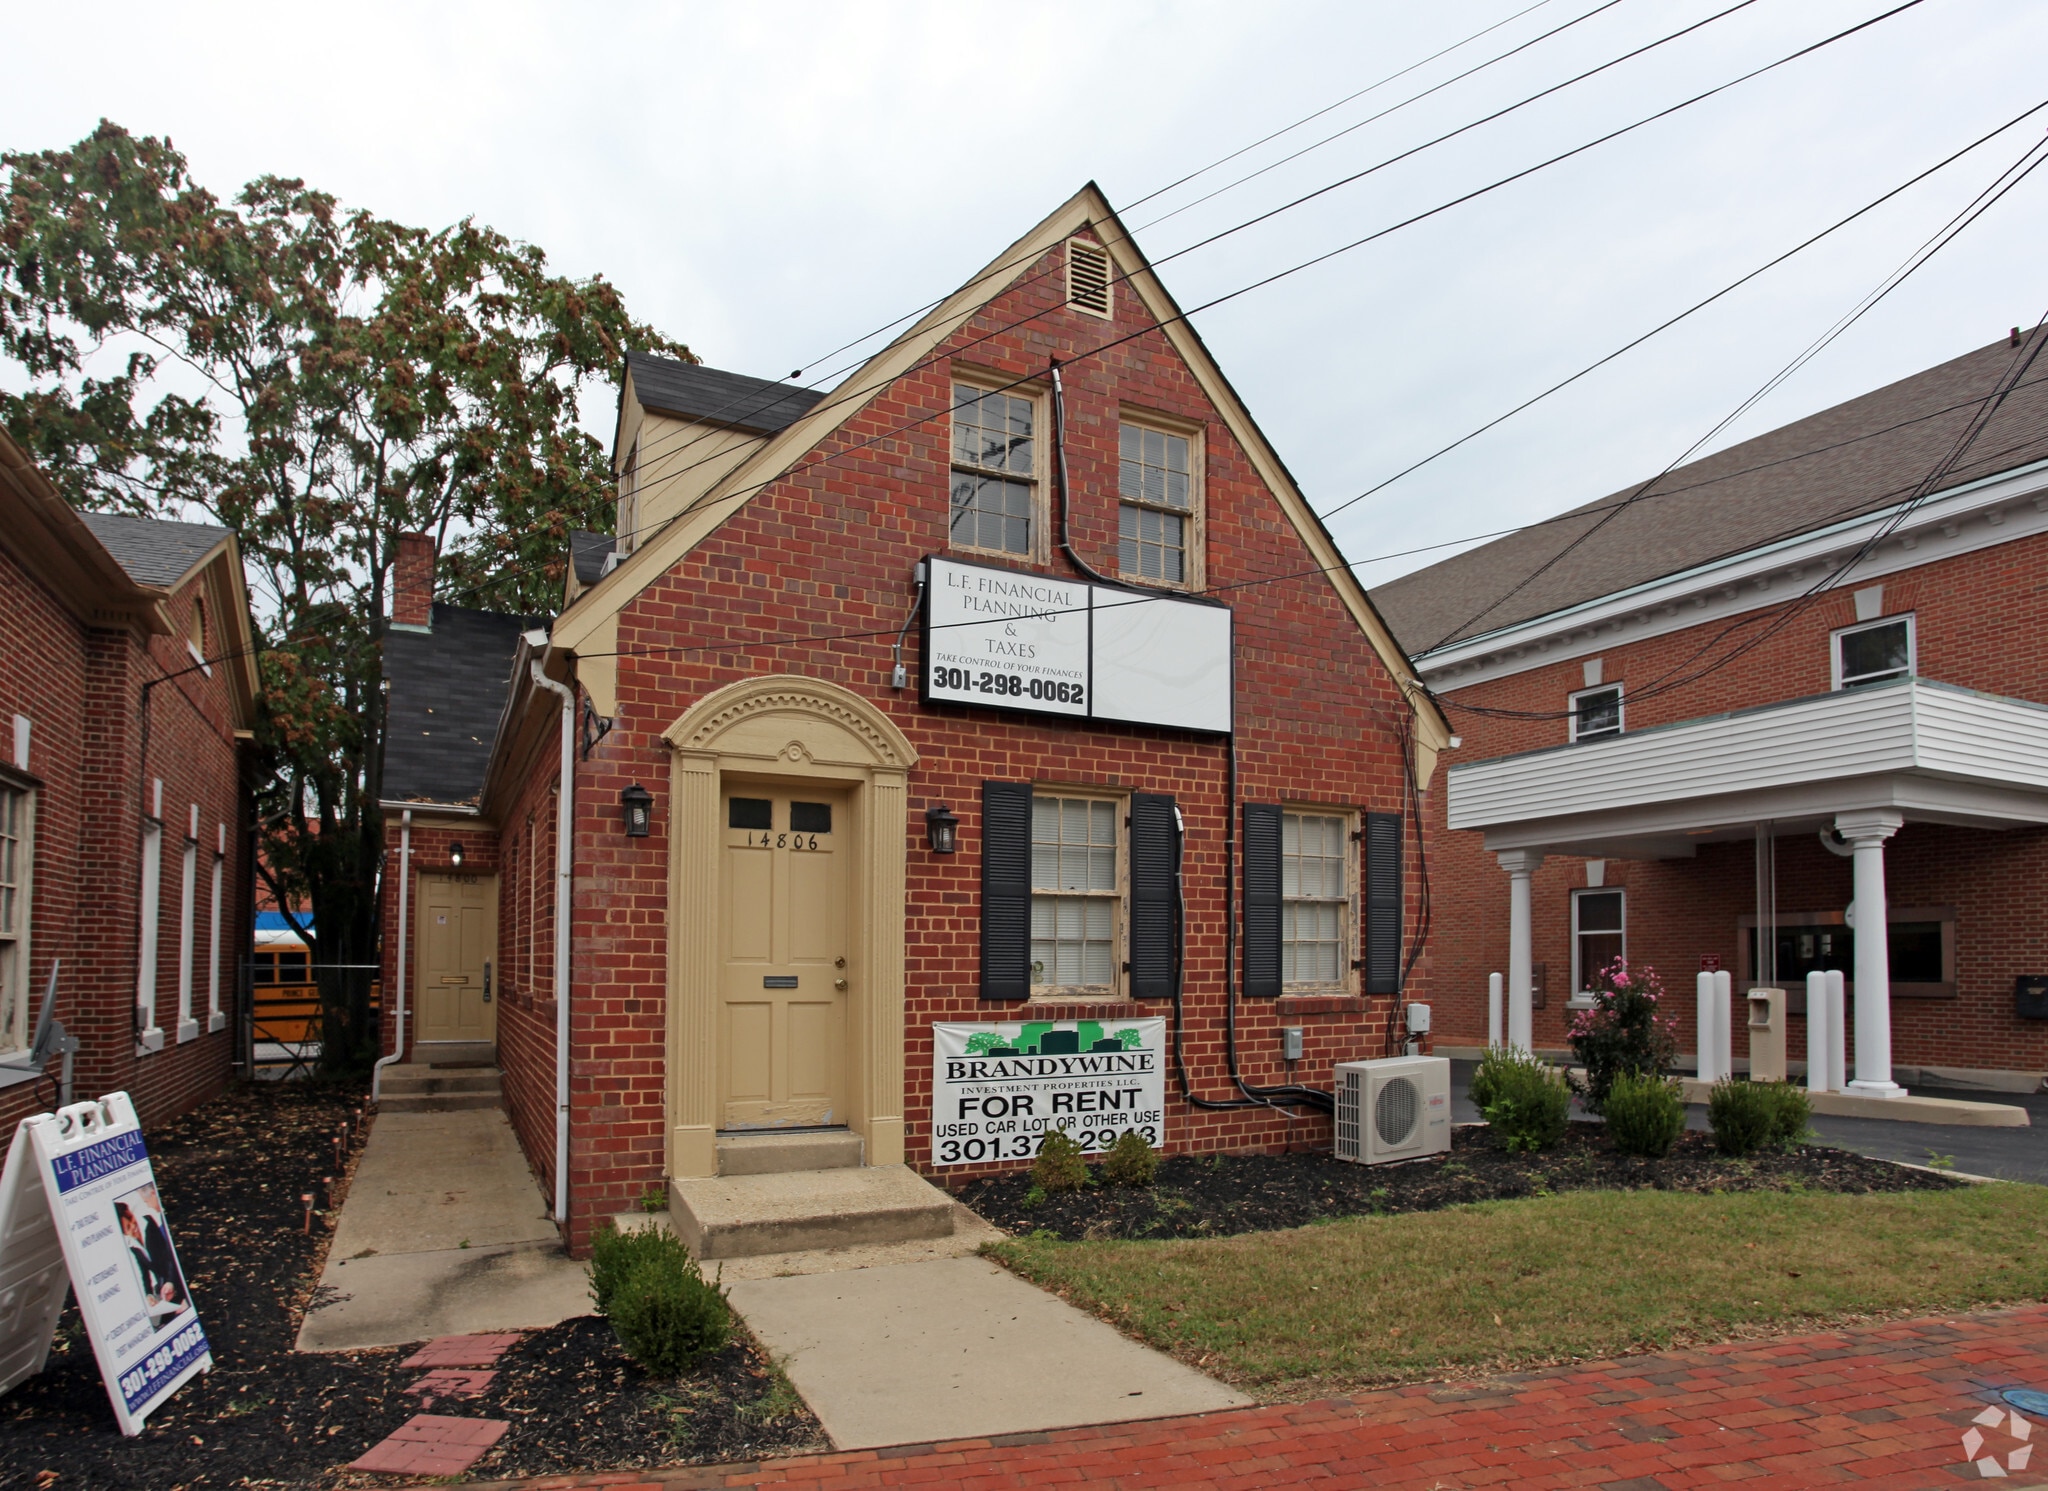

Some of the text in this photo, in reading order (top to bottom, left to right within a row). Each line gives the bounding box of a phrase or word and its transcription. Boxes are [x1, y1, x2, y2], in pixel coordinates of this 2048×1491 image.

[948, 572, 1073, 606] L.F. FINANCIAL
[963, 595, 1057, 623] PLANNING
[1004, 622, 1017, 637] &
[985, 638, 1036, 659] TAXES
[936, 652, 1083, 679] TAKE CONTROL OF YOUR FINANCES
[933, 665, 1084, 705] 301-298-0062
[748, 831, 818, 850] 14806
[945, 1053, 1155, 1080] BRANDYWINE
[961, 1078, 1140, 1095] INVESTMENT PROPERTIES LLC.
[958, 1088, 1142, 1120] FOR RENT
[936, 1110, 1161, 1138] USED CAR LOT OR OTHER USE
[56, 1131, 142, 1174] L.F. FINANCIAL
[71, 1148, 136, 1185] PLANNING
[121, 1322, 204, 1399] 301-298-0062
